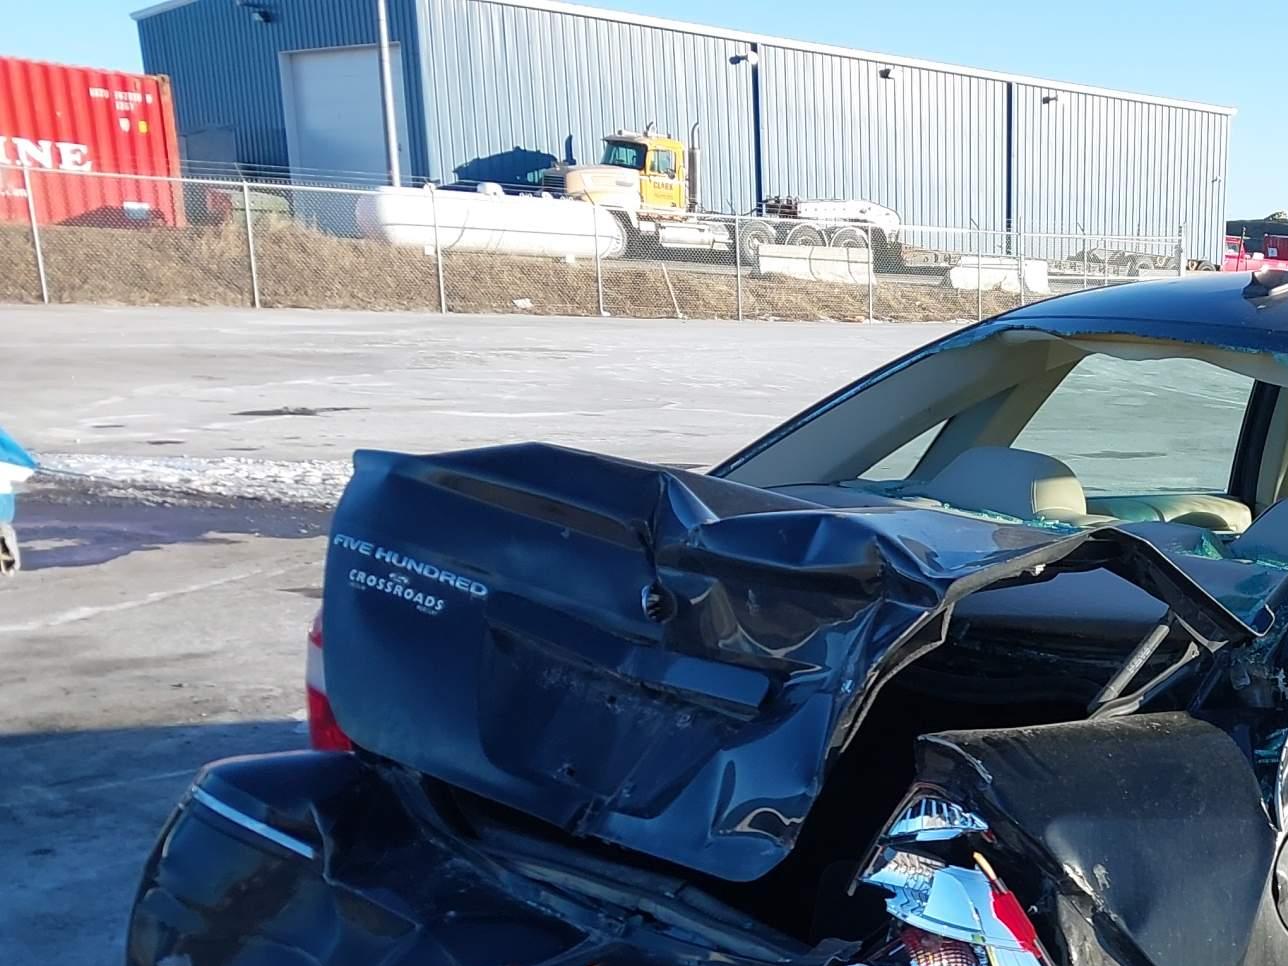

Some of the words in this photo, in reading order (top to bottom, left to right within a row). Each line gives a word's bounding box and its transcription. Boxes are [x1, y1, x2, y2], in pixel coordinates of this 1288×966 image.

[333, 533, 375, 555] FIVE
[374, 546, 489, 597] HUNDRED
[348, 568, 445, 611] CROSSROADS
